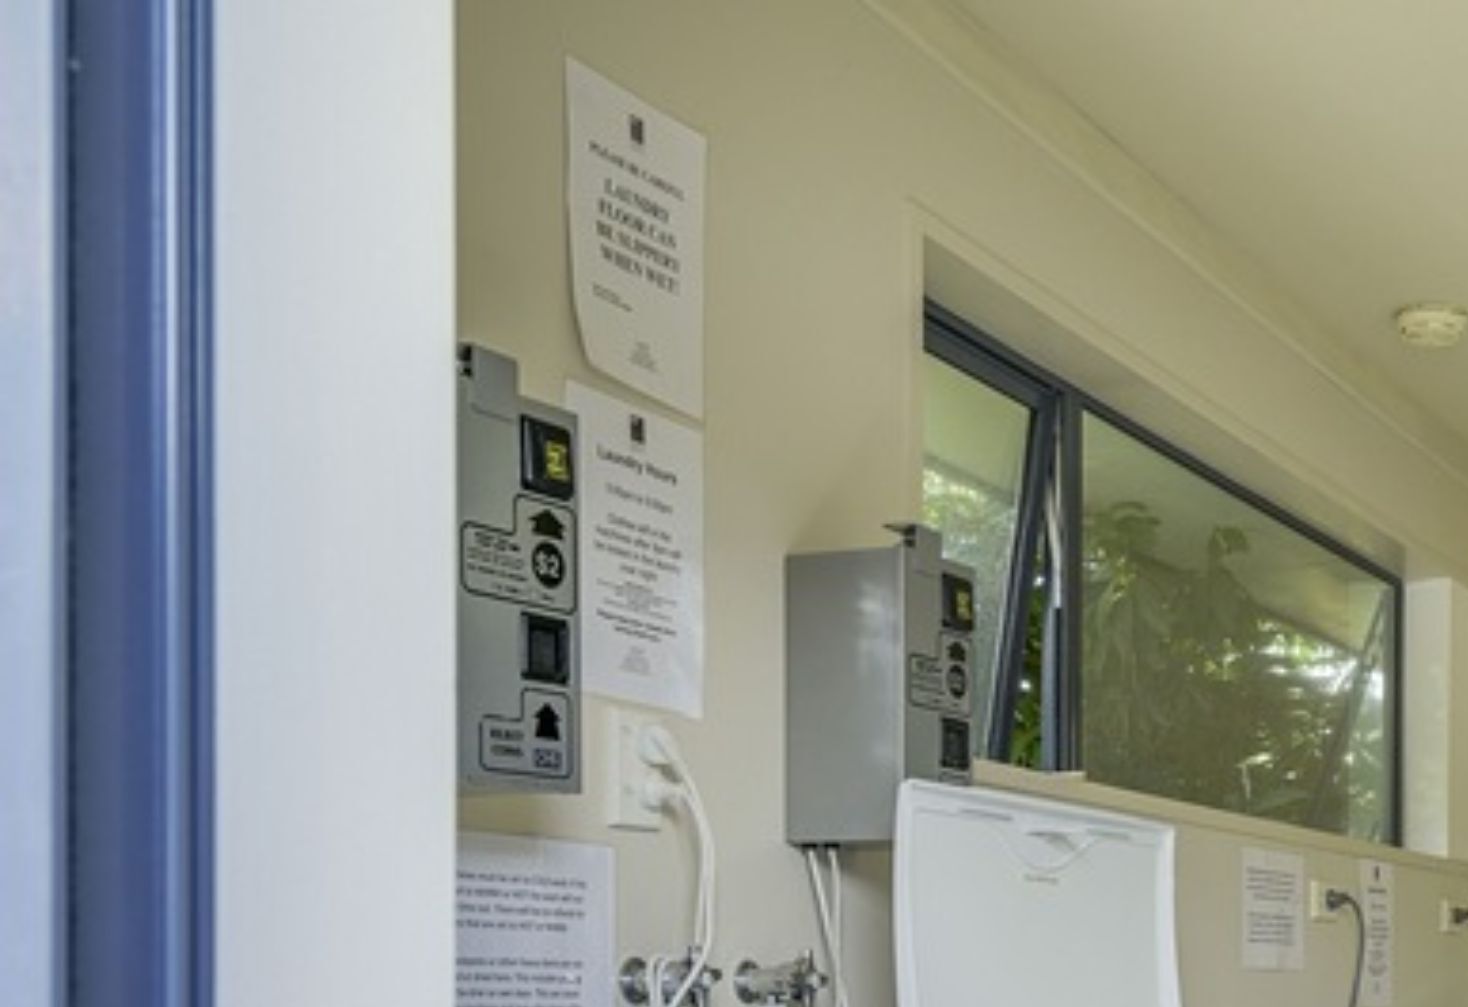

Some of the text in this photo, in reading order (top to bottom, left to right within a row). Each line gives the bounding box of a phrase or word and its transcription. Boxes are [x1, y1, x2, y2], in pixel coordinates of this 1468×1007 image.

[598, 197, 647, 236] FLOOR
[604, 178, 669, 224] LAUNDRY
[596, 443, 642, 476] Laundry
